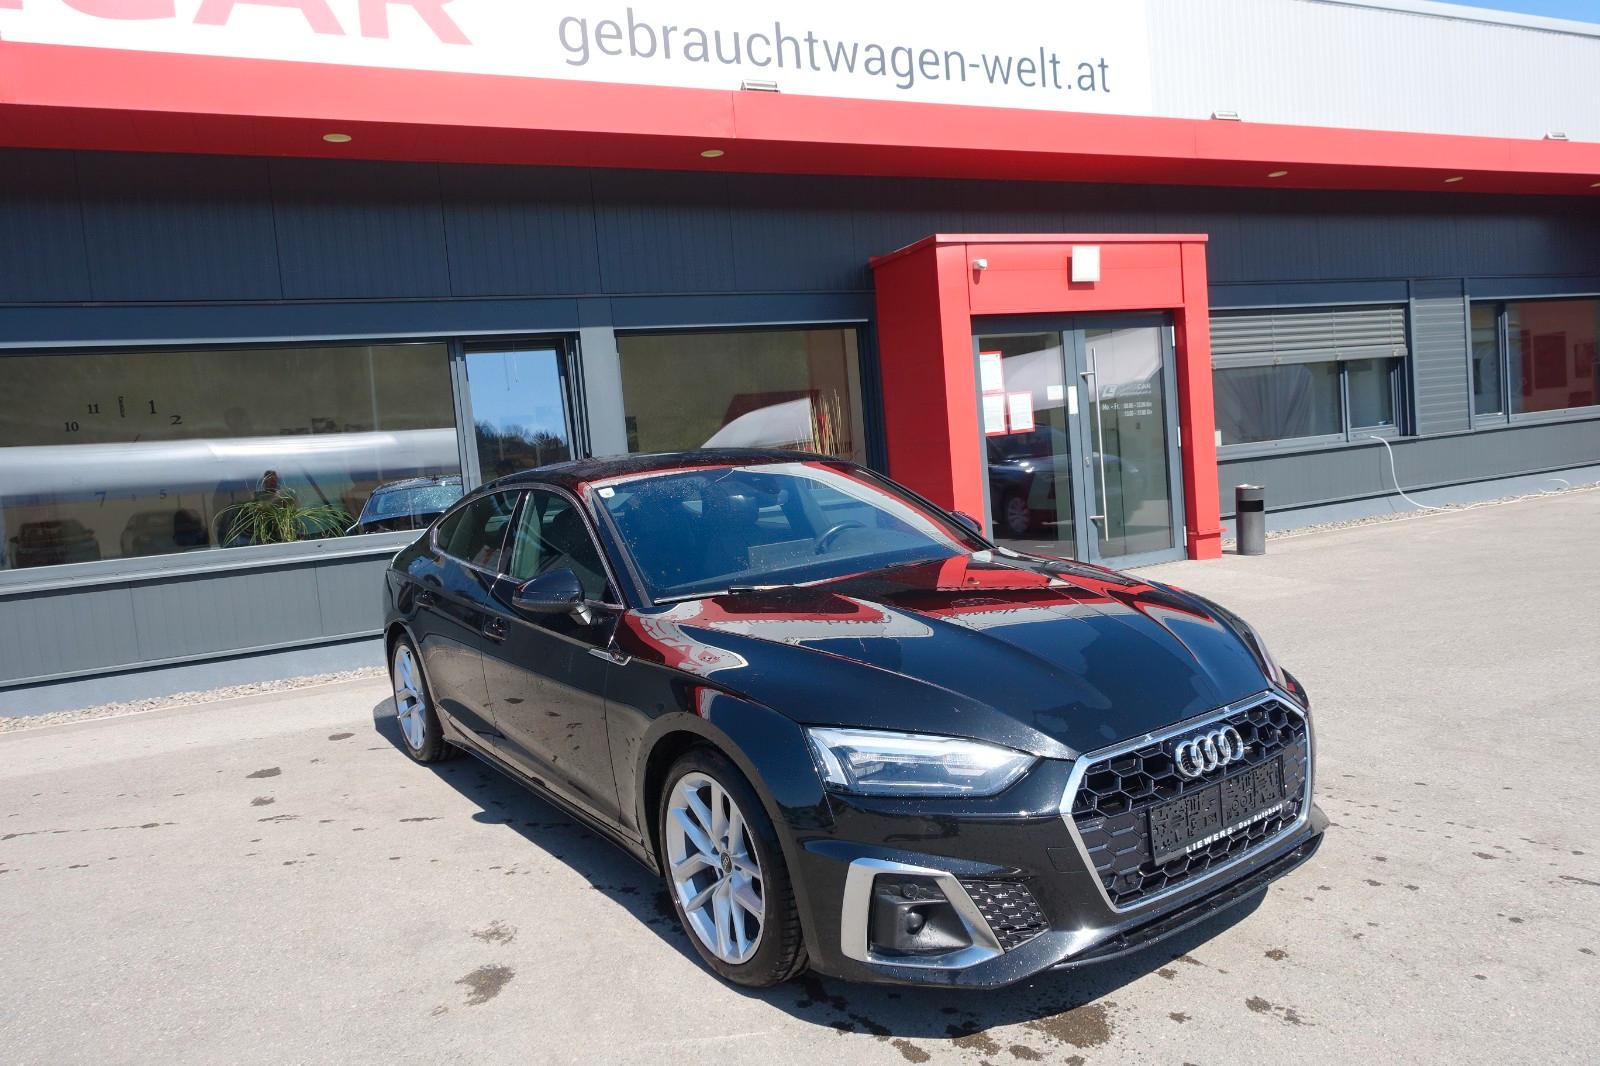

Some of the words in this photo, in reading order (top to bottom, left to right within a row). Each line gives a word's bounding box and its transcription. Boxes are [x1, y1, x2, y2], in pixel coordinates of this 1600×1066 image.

[558, 7, 1111, 93] gebrauchtwagen-welt.at
[88, 403, 100, 415] 11
[170, 414, 183, 425] 2
[64, 421, 80, 433] 10
[1185, 827, 1236, 853] LIEWERS.
